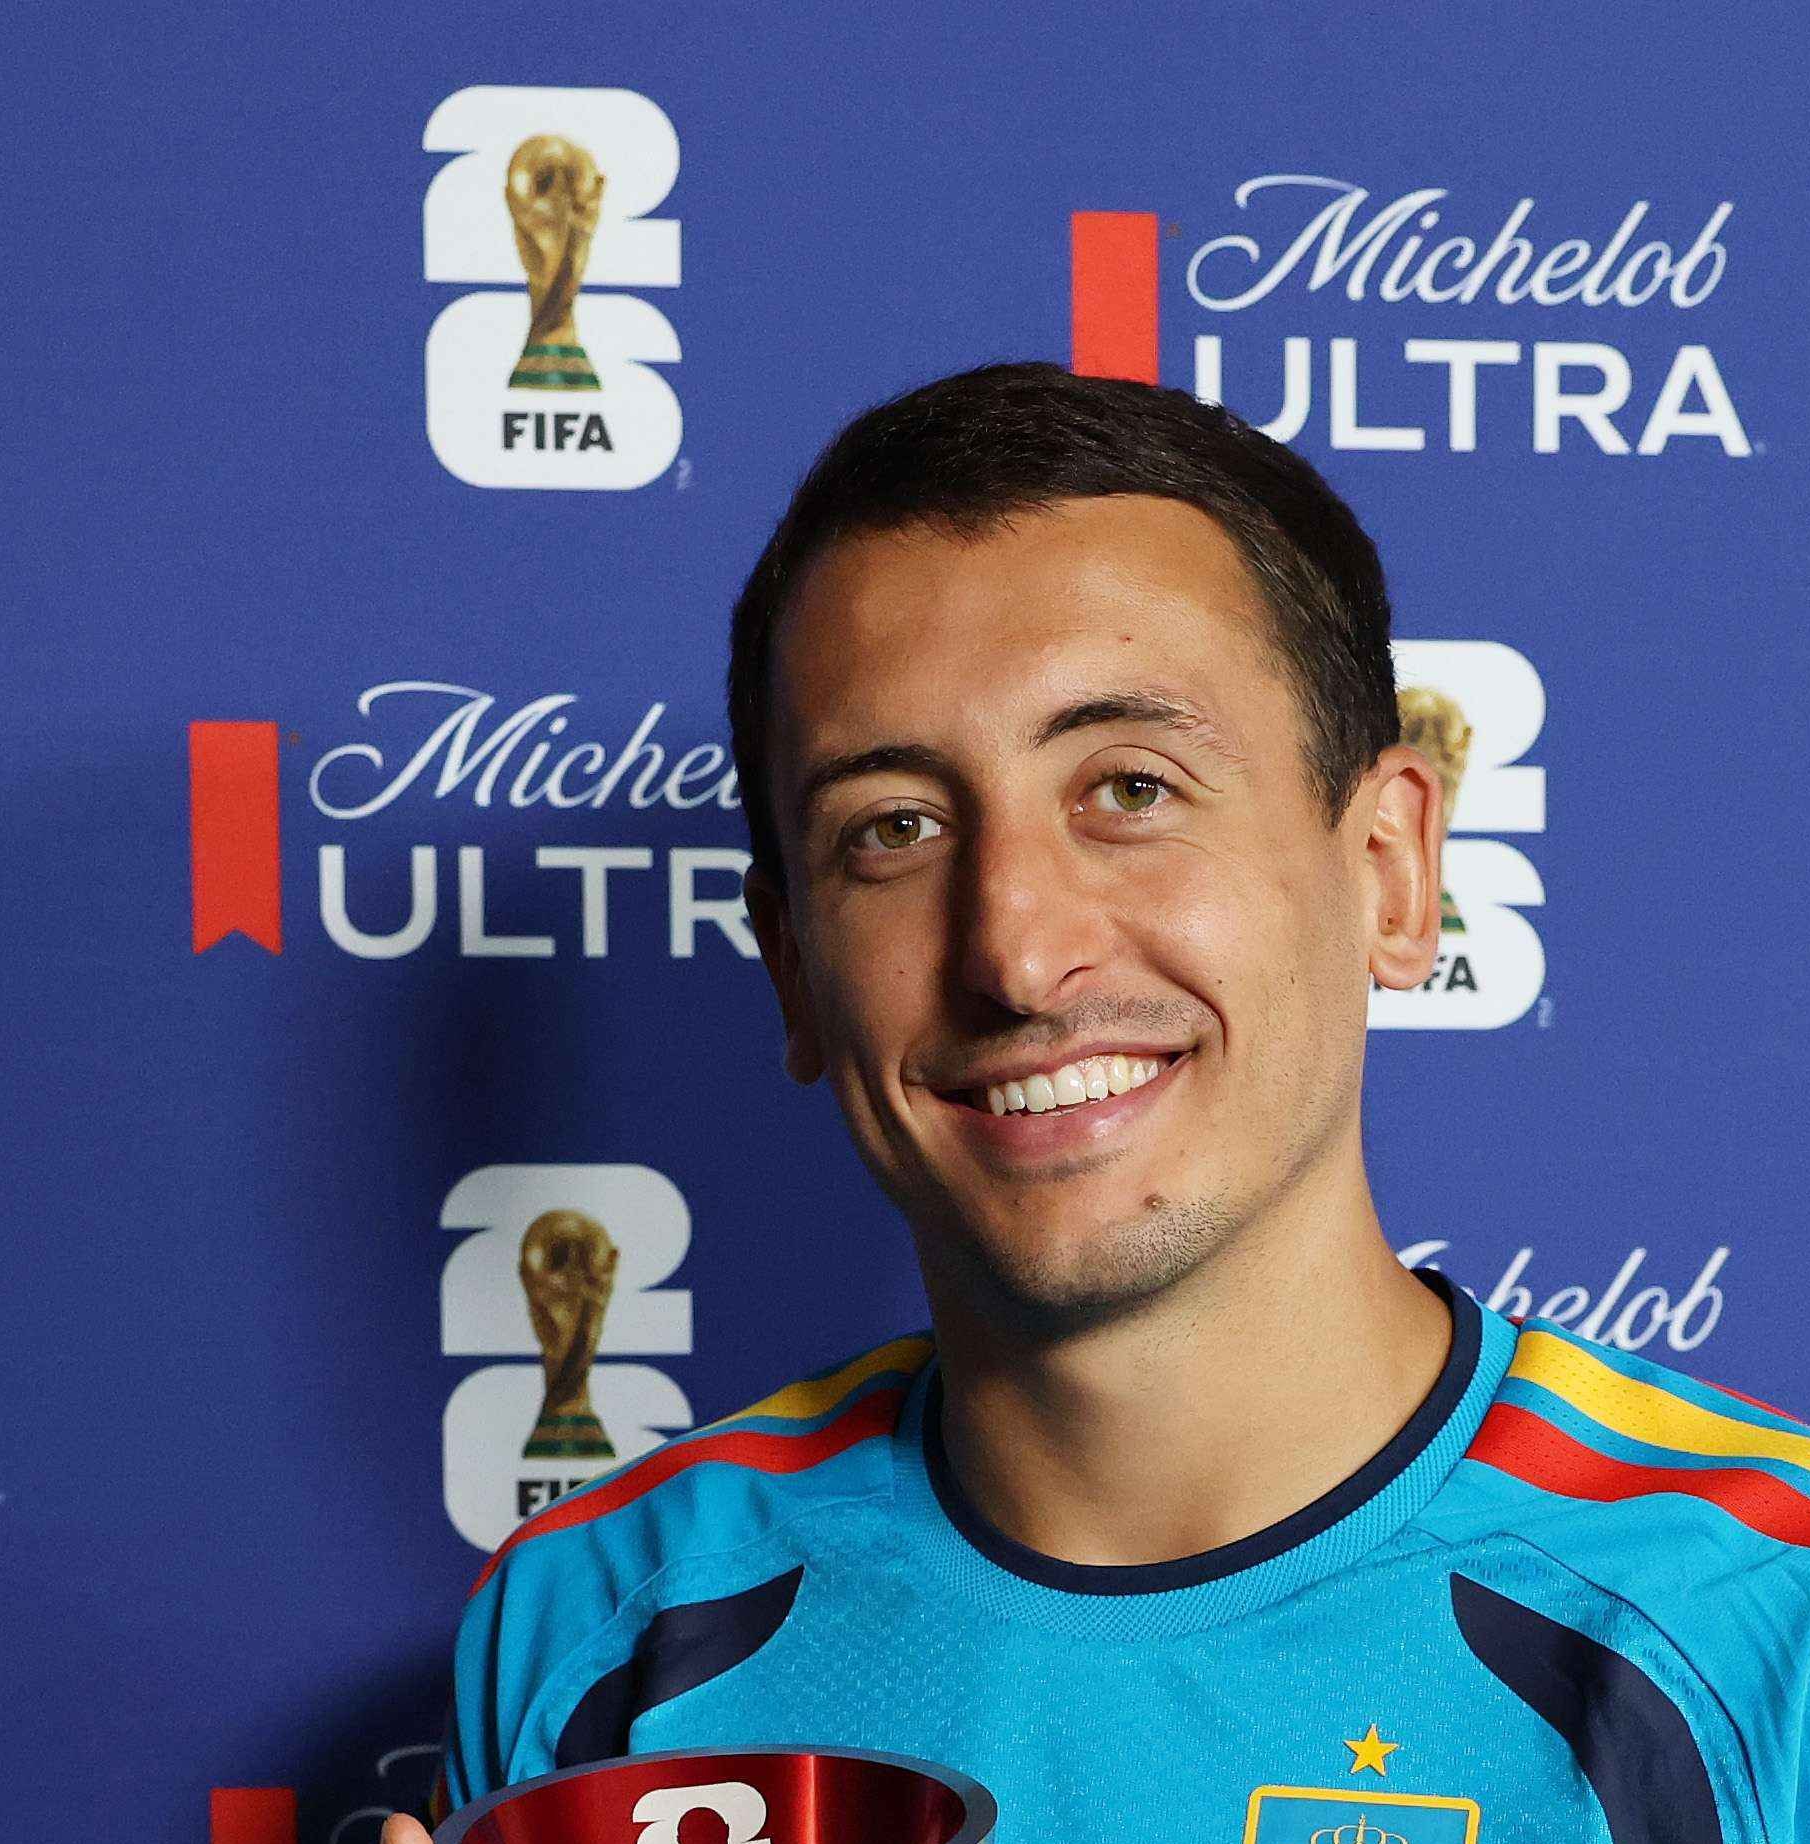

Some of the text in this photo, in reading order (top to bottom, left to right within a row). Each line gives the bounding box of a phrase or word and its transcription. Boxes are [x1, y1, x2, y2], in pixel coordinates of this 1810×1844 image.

[1187, 175, 1733, 311] Michelob
[502, 412, 613, 452] FIFA
[1195, 335, 1752, 457] ULTRA
[310, 681, 741, 819] Miche
[319, 845, 762, 958] ULTR
